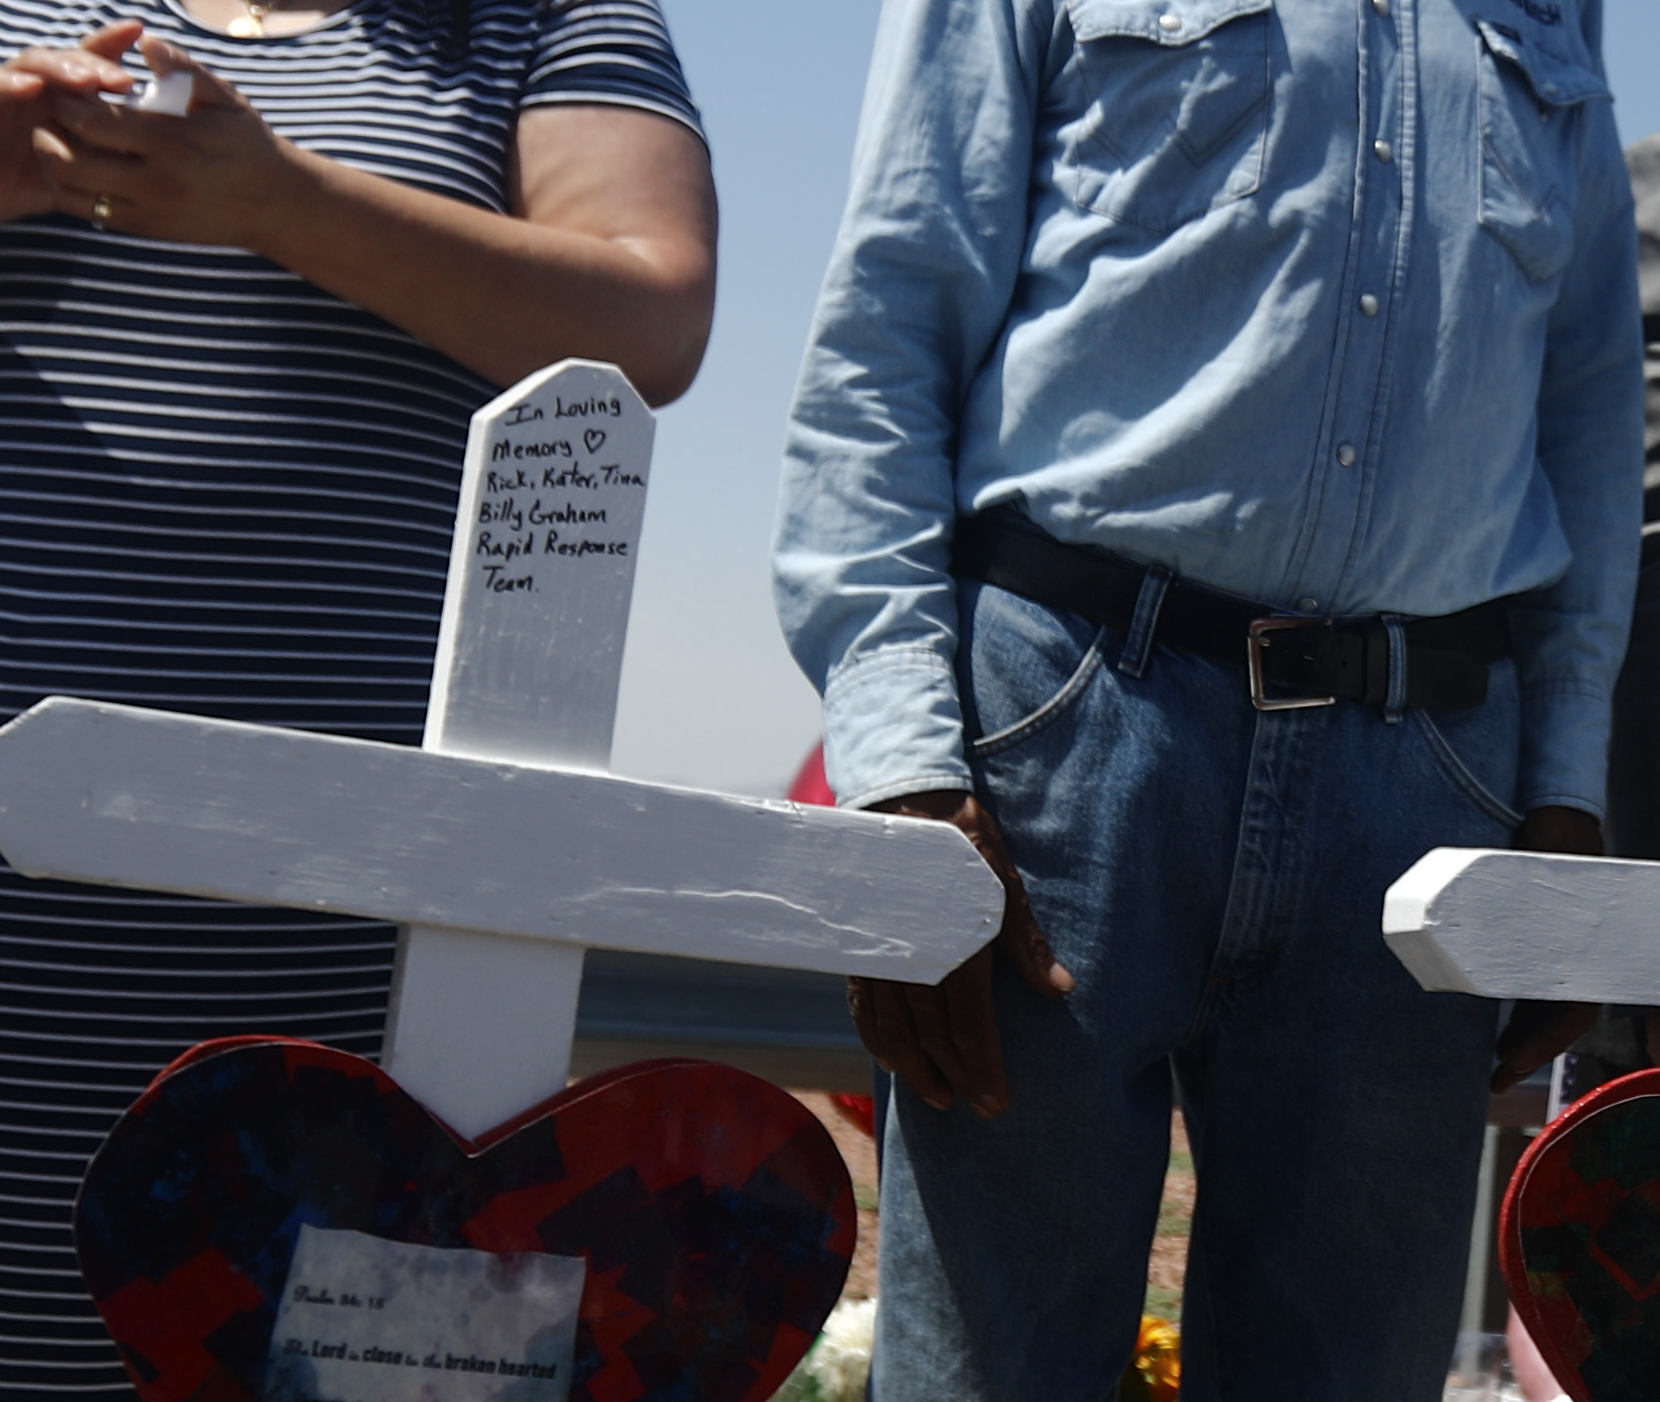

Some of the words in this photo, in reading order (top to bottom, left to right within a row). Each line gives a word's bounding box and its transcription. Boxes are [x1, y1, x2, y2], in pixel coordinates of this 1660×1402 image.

[504, 405, 544, 426] In
[556, 396, 621, 418] Loving
[492, 439, 573, 462] Memory
[600, 465, 645, 487] Tina
[478, 498, 522, 531] Billy
[529, 500, 607, 523] Graham
[477, 532, 533, 562] Rapid
[544, 530, 628, 558] Response
[312, 1339, 348, 1360] Lord
[362, 1344, 404, 1365] close
[444, 1351, 496, 1374] broken
[498, 1357, 557, 1380] hearted
